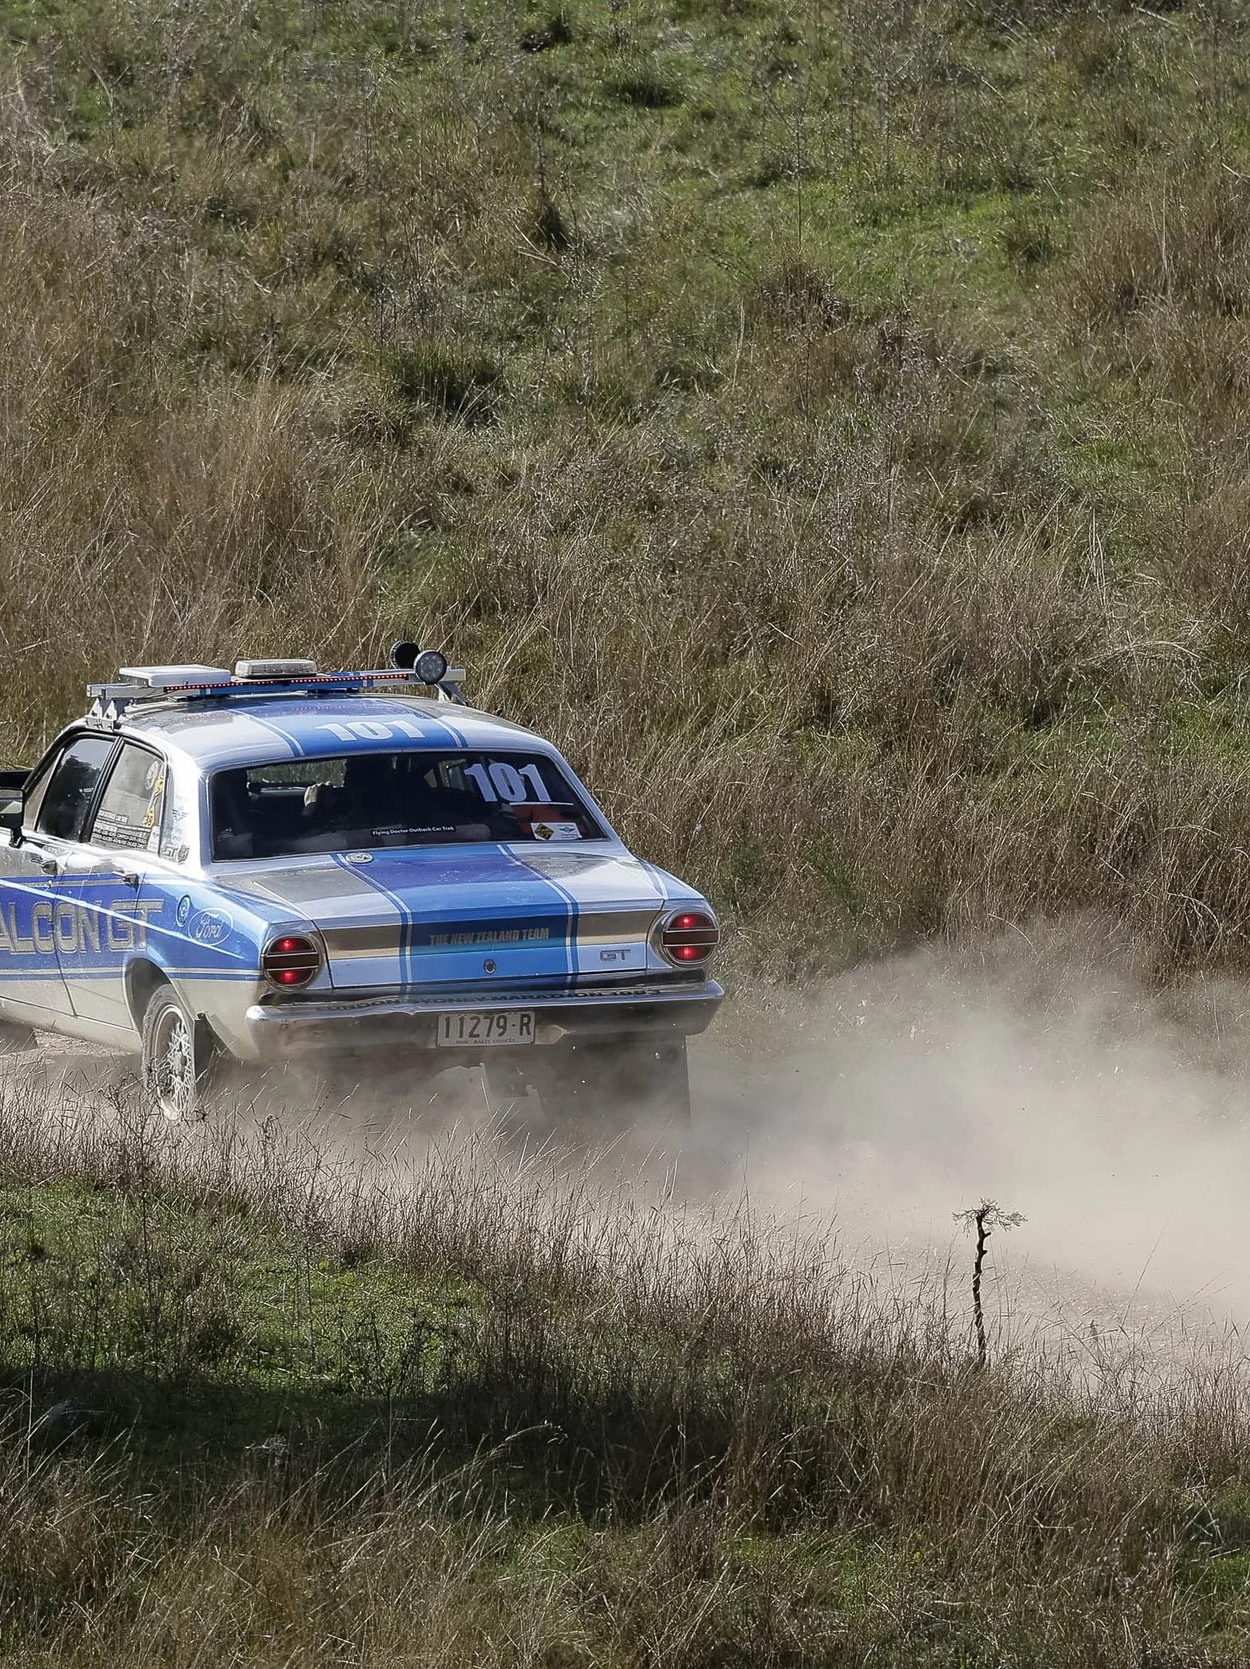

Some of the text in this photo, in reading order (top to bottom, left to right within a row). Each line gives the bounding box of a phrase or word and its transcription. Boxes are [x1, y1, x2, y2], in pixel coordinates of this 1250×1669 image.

[315, 720, 425, 741] 101
[463, 762, 551, 801] 101
[108, 898, 164, 952] GT
[195, 911, 224, 938] Ford
[430, 927, 549, 946] THE NEW ZEALAND TEAM
[600, 949, 631, 962] GT
[445, 1014, 531, 1039] 11279-R
